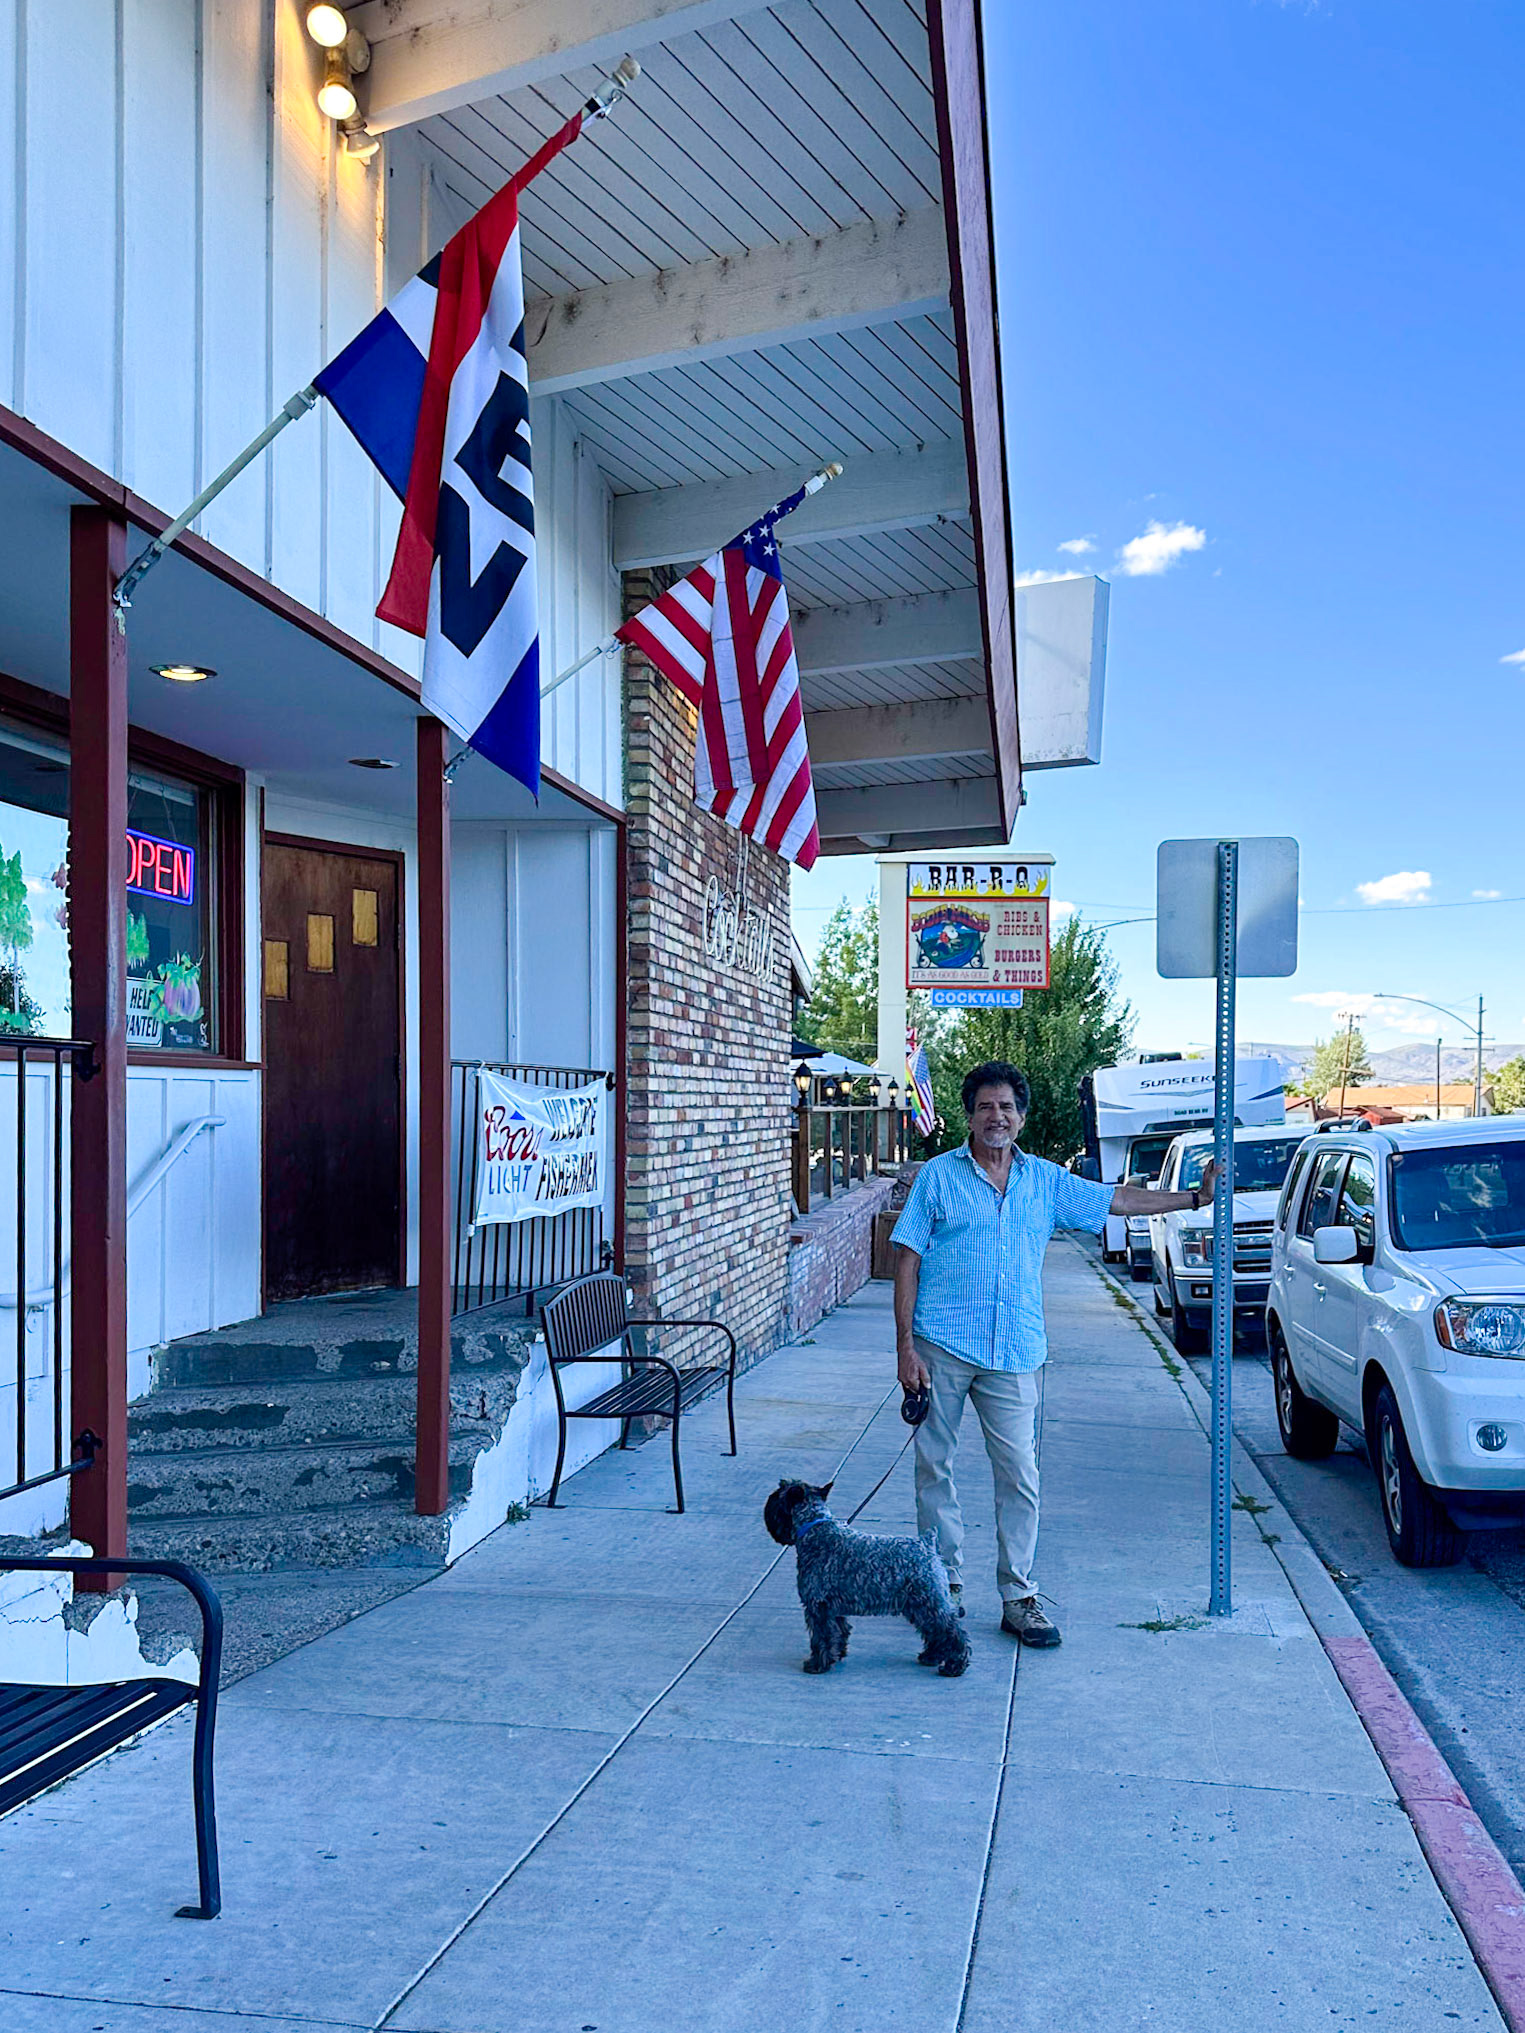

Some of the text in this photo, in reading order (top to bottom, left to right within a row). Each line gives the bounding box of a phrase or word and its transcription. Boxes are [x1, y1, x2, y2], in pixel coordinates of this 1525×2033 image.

[1004, 911, 1040, 922] RIBS &
[997, 925, 1043, 936] CHICKEN
[994, 950, 1041, 962] BURGERS
[993, 970, 1042, 982] & THINGS
[934, 992, 1019, 1004] COCKTAILS
[535, 1151, 598, 1200] FISHERMEN
